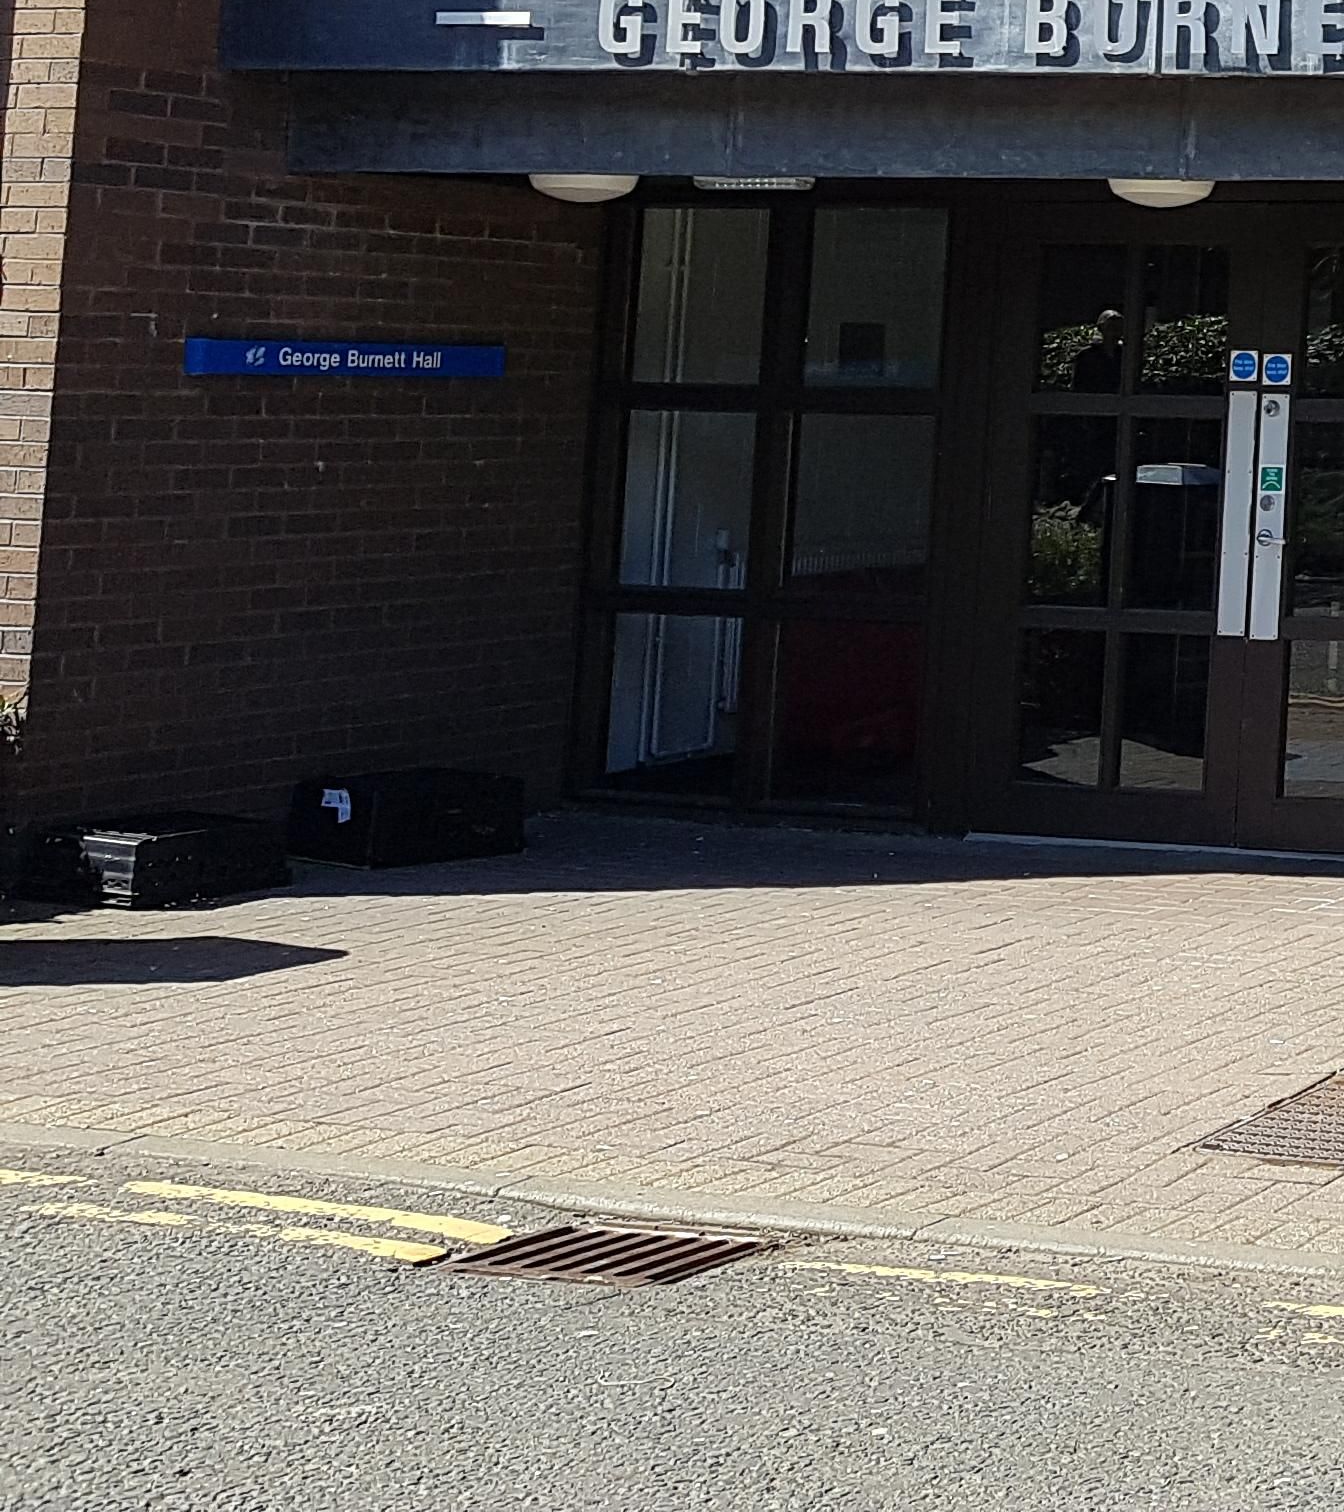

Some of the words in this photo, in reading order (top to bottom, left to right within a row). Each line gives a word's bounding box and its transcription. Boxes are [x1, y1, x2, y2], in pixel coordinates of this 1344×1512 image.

[278, 346, 341, 371] George
[347, 349, 406, 369] Burnett
[412, 351, 442, 369] Hall
